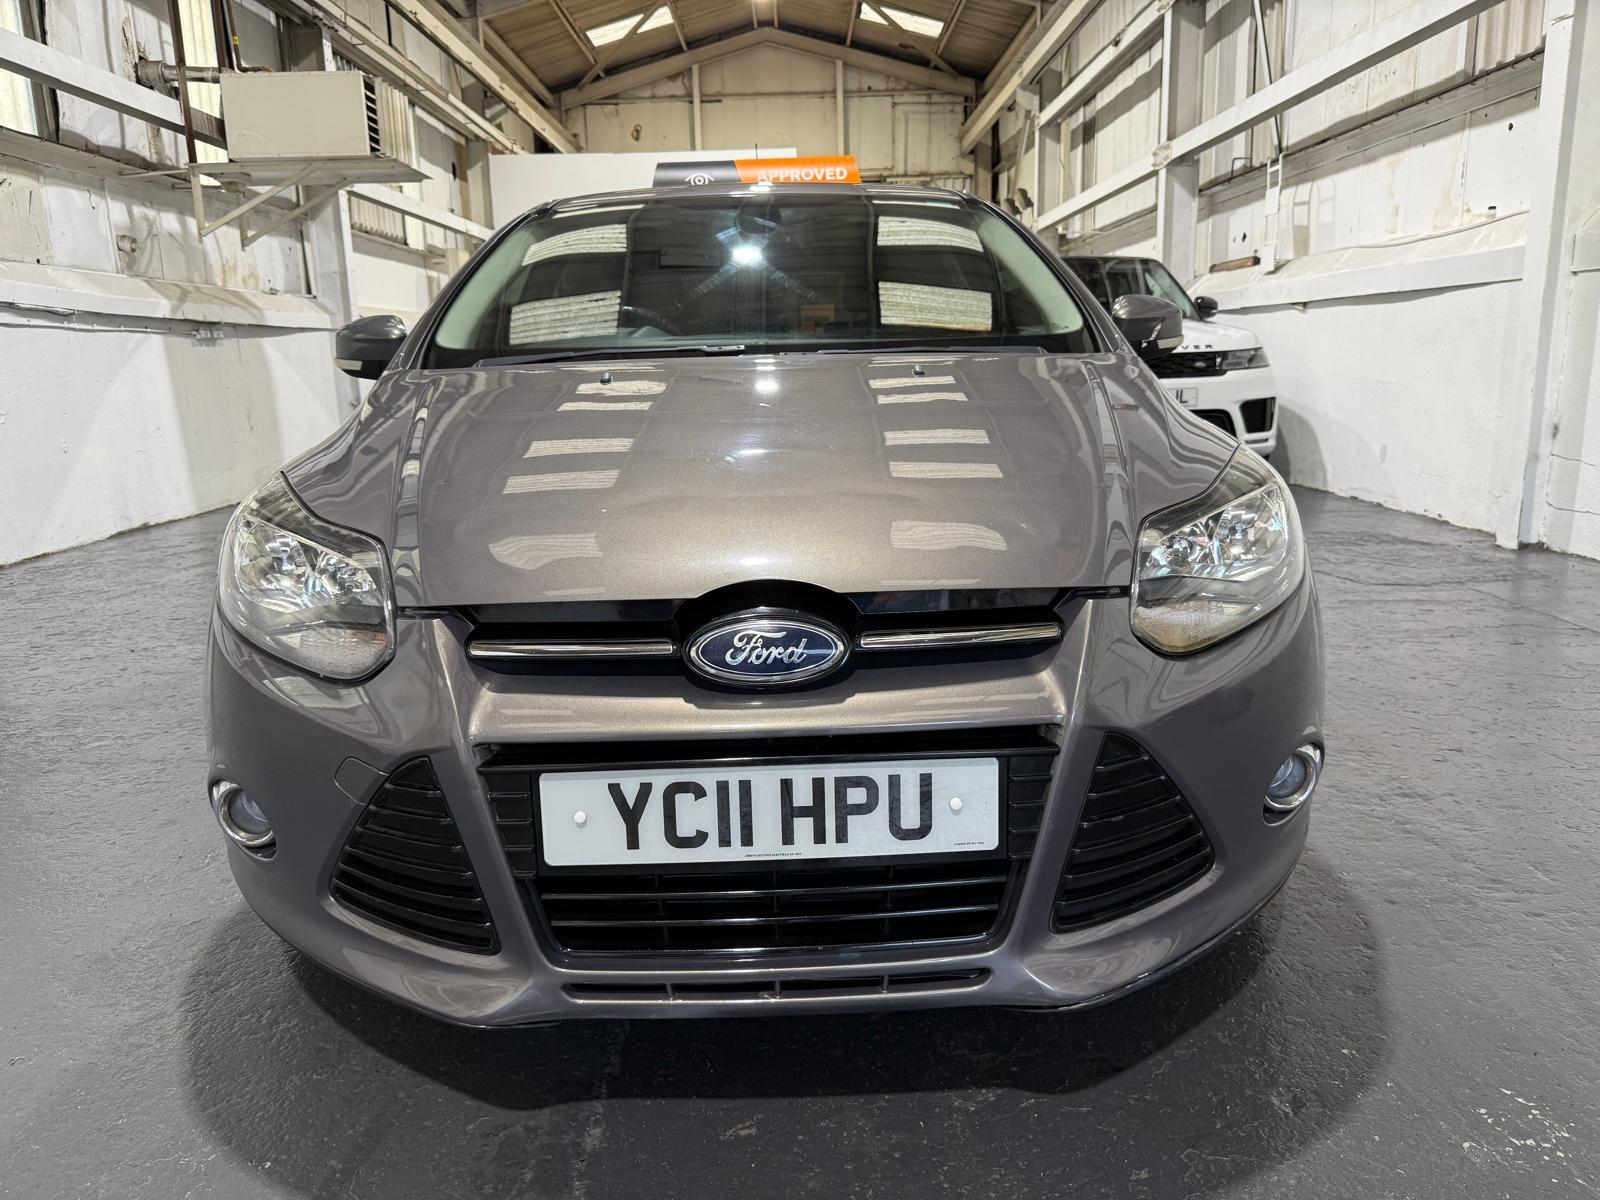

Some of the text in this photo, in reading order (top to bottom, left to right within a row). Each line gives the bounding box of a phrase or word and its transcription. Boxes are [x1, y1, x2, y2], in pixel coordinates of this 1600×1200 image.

[757, 167, 848, 182] APPROVED
[725, 630, 808, 666] Ford
[607, 772, 933, 850] YC11 HPU
